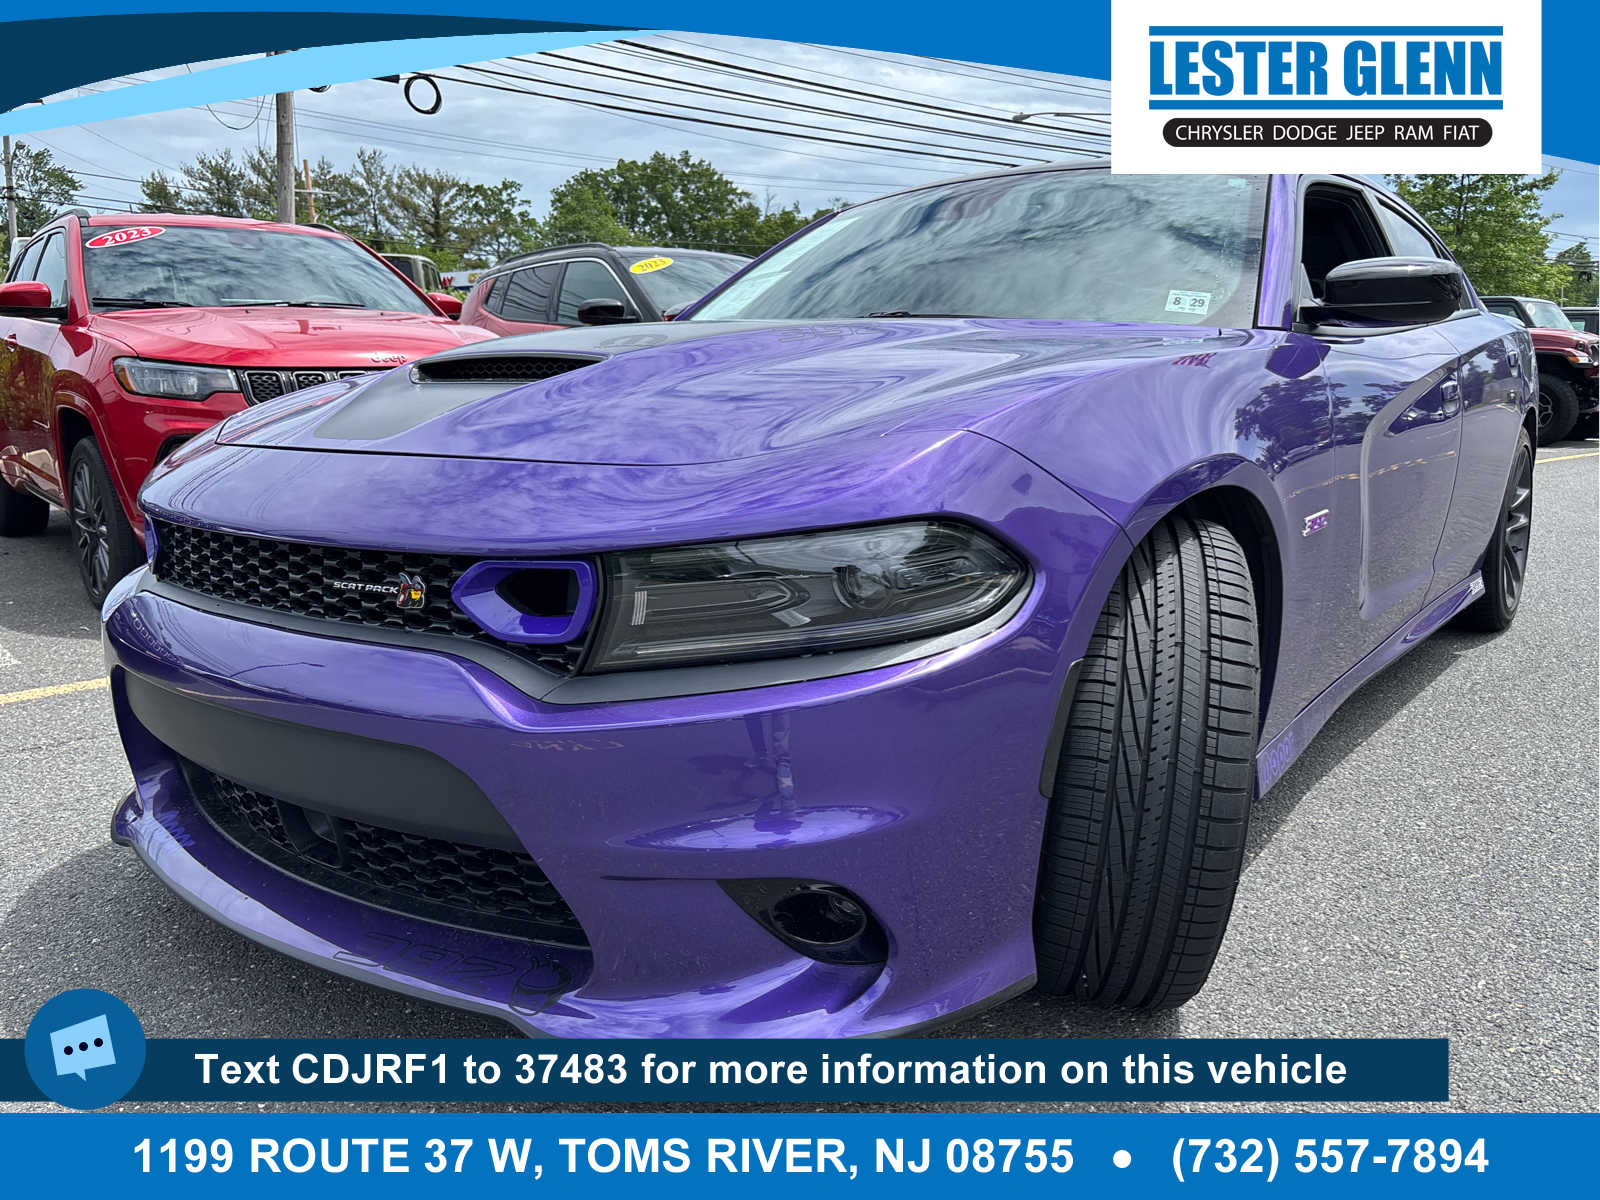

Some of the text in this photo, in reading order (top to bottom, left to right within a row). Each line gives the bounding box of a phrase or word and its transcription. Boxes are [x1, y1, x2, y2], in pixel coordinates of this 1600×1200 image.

[102, 227, 152, 247] 2023
[1173, 296, 1206, 308] 8 29
[333, 581, 399, 594] SCAT PACK
